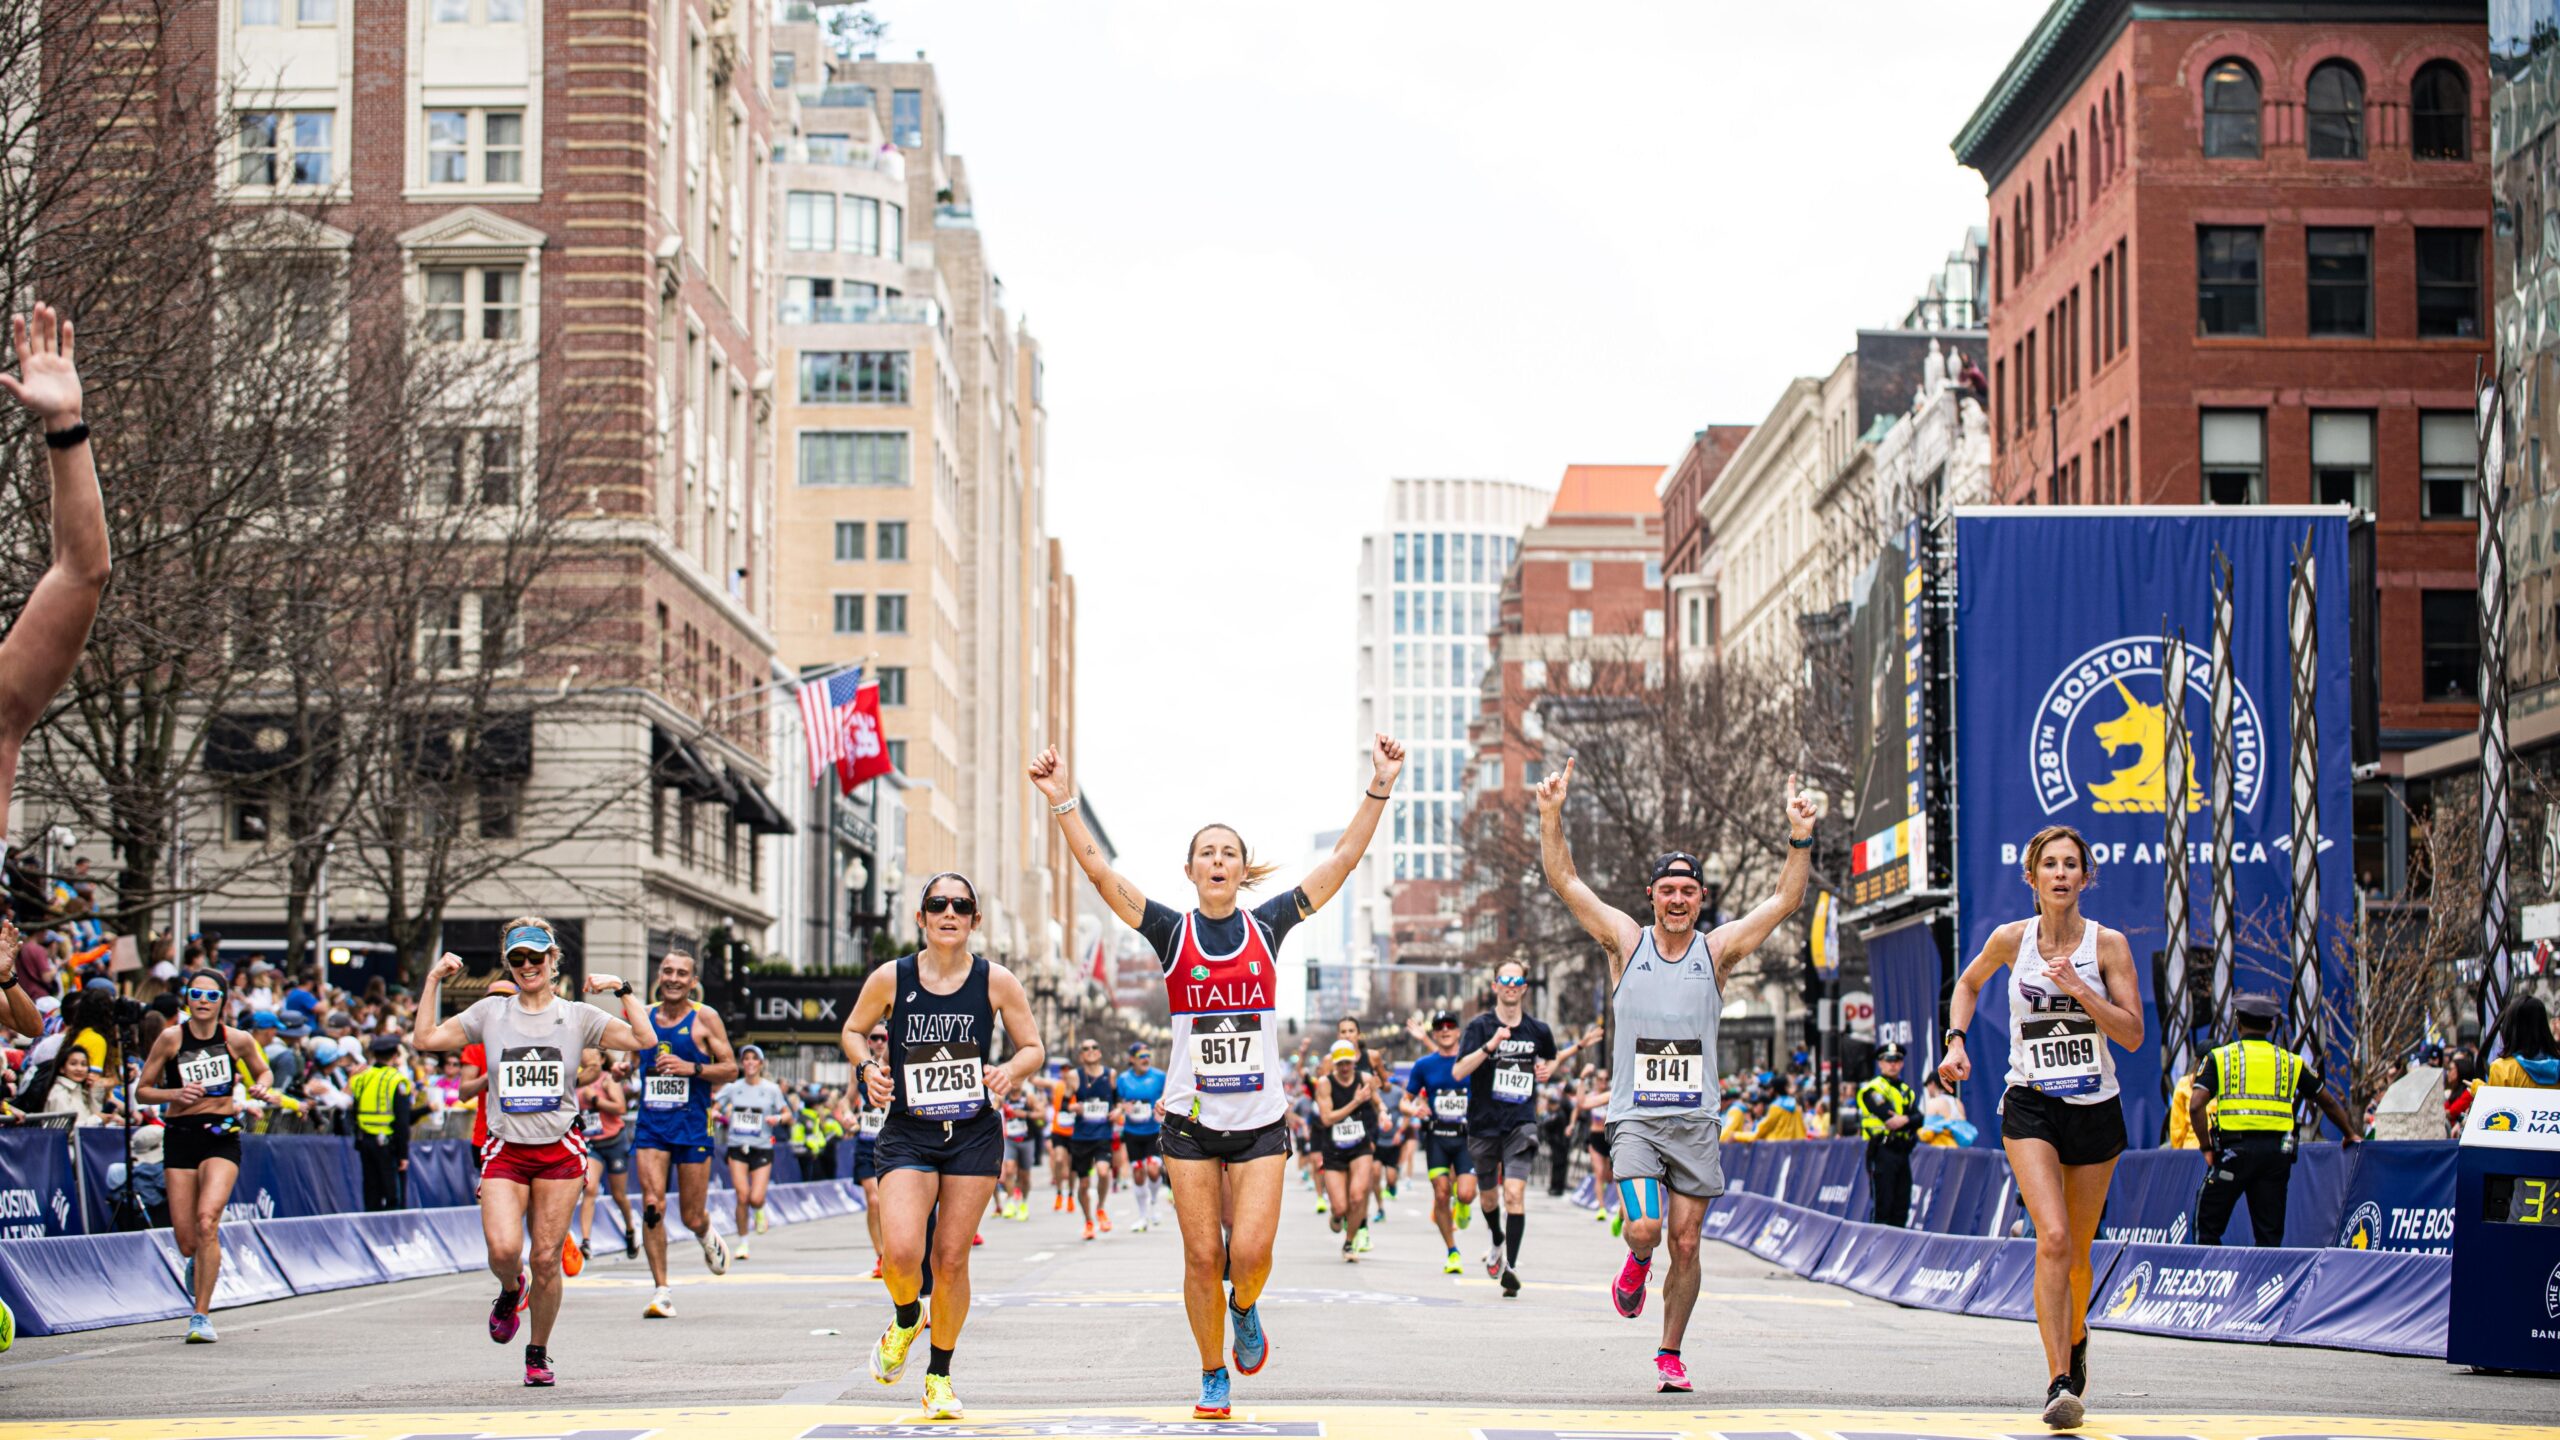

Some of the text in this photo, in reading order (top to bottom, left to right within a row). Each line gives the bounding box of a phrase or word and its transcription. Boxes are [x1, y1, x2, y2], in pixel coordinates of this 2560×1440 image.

[2050, 644, 2152, 719] BOSTON
[2039, 725, 2065, 800] 128TH
[2091, 842, 2267, 865] OF AERCA
[1187, 982, 1266, 1008] ITALIA
[754, 997, 838, 1020] LENOX
[906, 1014, 974, 1042] NAVY
[1201, 1037, 1251, 1064] 9517
[2029, 1038, 2094, 1069] 15069
[185, 1060, 225, 1082] 15131
[506, 1065, 558, 1087] 13445
[913, 1063, 976, 1093] 12253
[1499, 1073, 1530, 1088] 11427
[1646, 1058, 1689, 1081] 8141
[2045, 1083, 2079, 1091] MARATHON
[2530, 1110, 2560, 1121] 128
[2389, 1207, 2455, 1239] THE BOS
[2153, 1267, 2182, 1296] THE
[2177, 1268, 2239, 1298] BOSTON
[2549, 1284, 2559, 1311] THE
